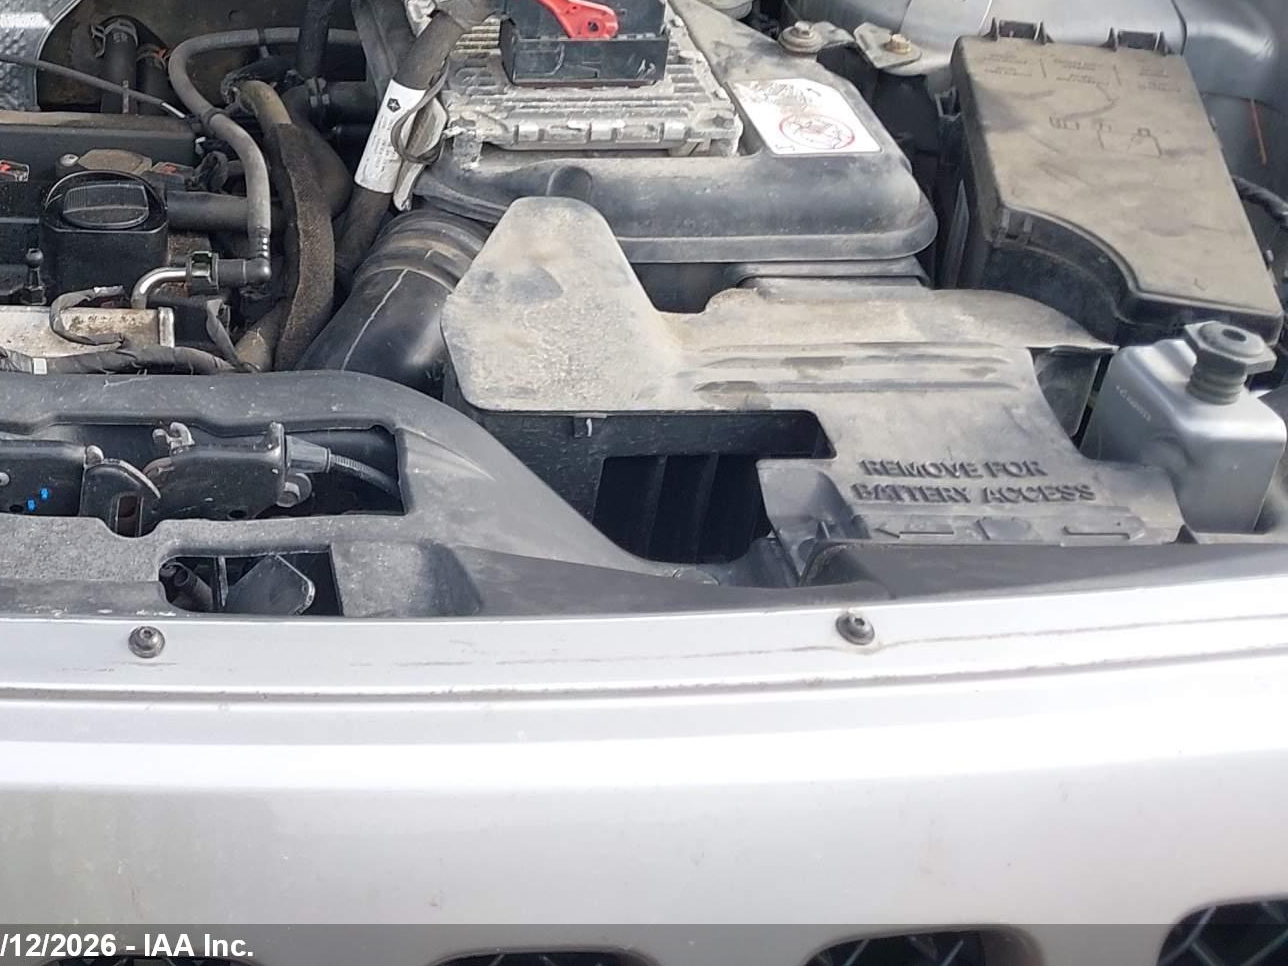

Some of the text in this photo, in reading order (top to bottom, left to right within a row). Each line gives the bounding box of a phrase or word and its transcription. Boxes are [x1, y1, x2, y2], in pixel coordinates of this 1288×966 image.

[860, 459, 1048, 479] REMOVE FOR
[850, 483, 1096, 504] BATTERY ACCESS
